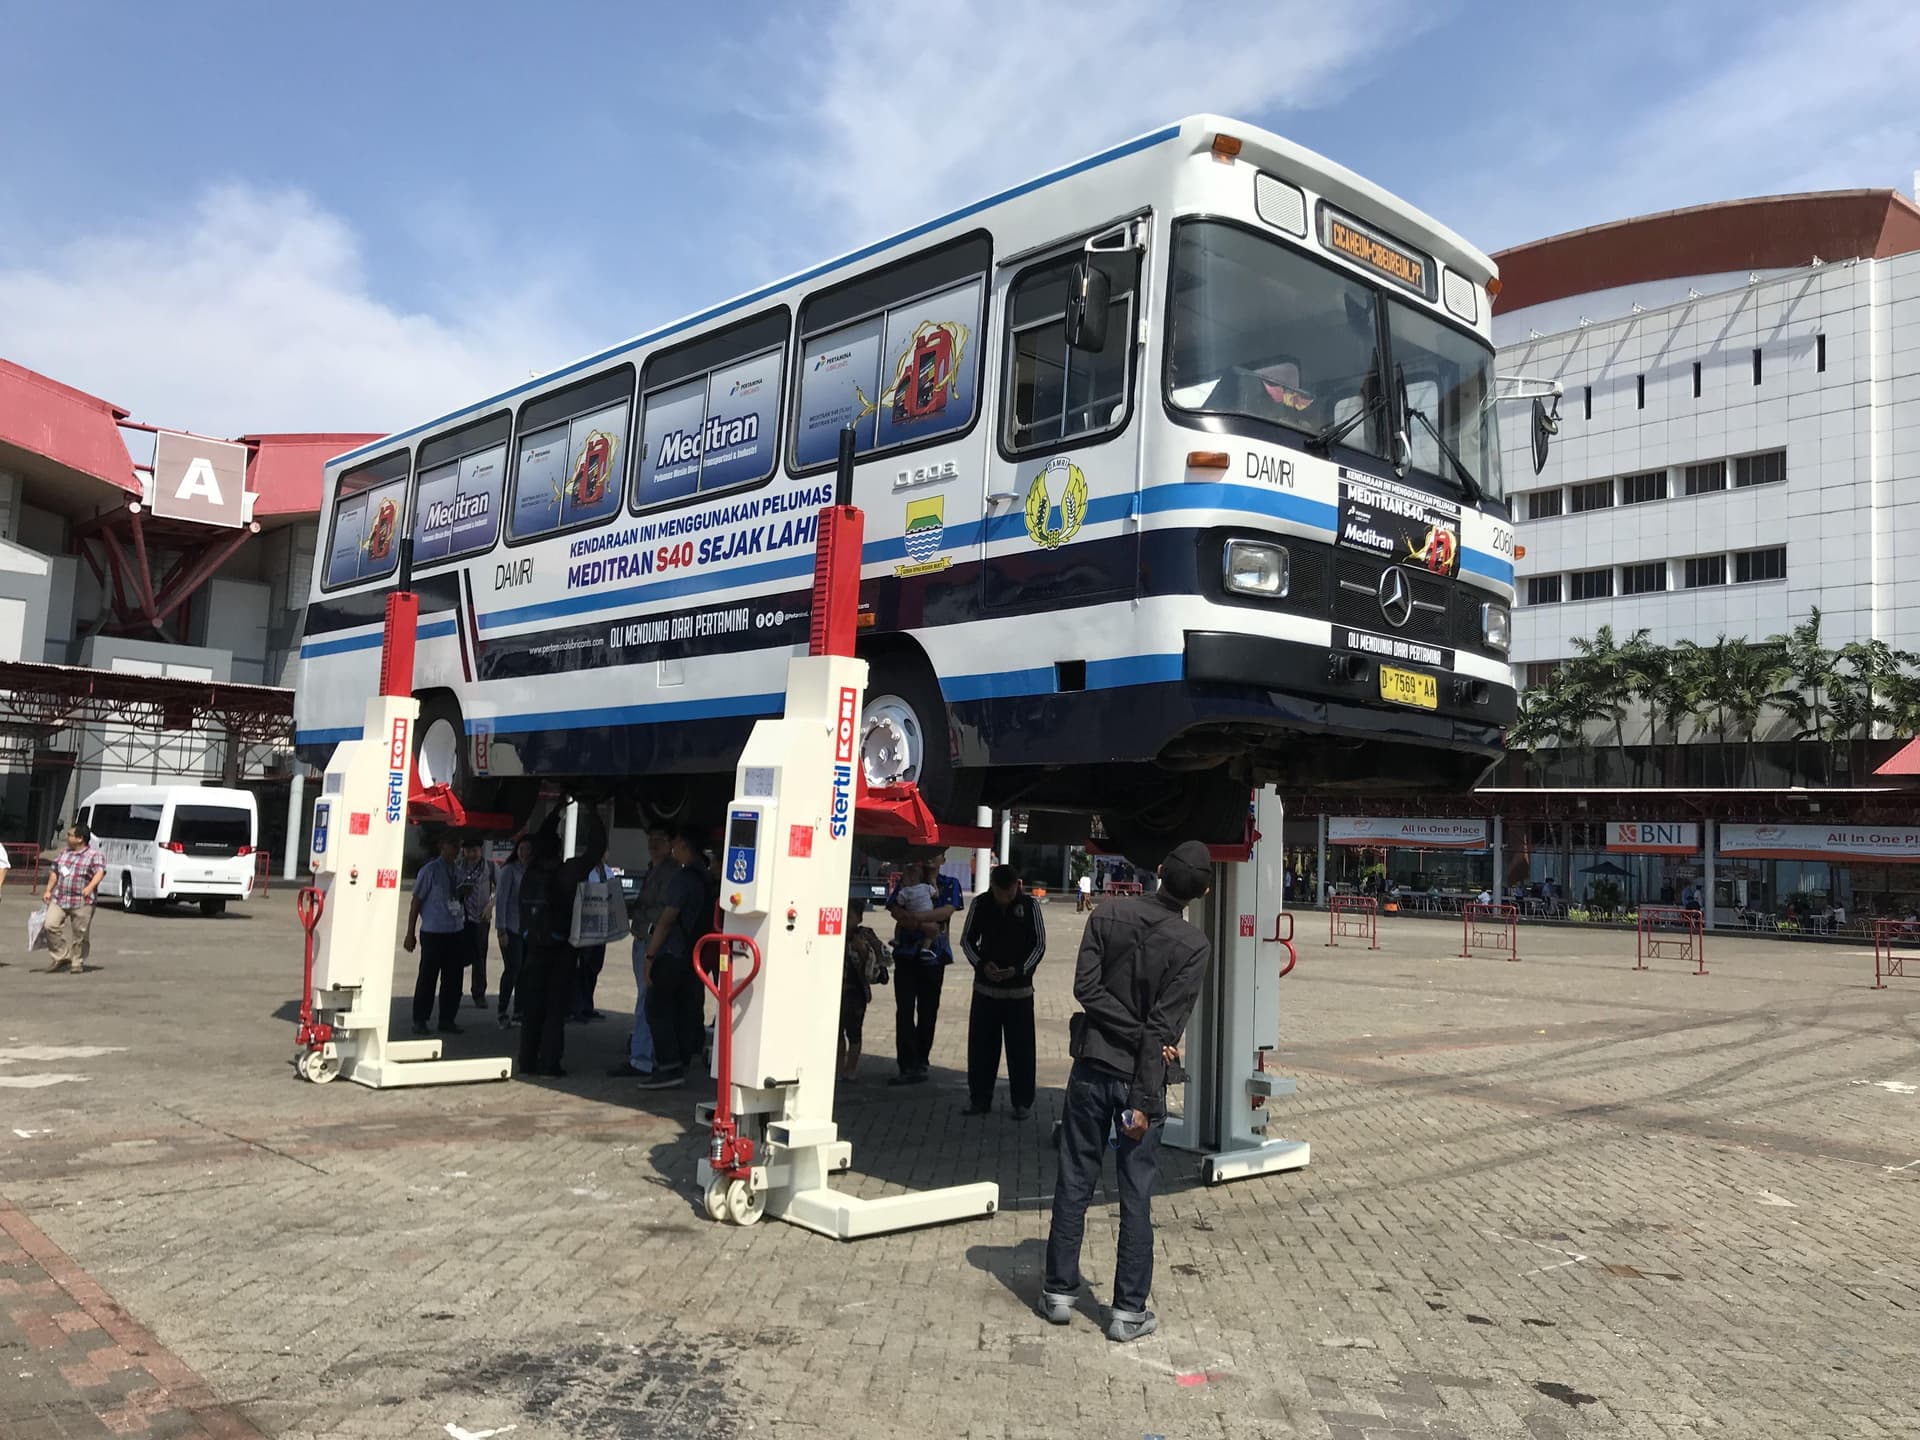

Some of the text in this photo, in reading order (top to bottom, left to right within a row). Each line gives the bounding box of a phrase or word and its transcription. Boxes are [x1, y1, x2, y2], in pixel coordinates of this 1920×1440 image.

[657, 413, 759, 468] Meditran
[175, 458, 224, 506] A
[1247, 452, 1295, 489] DAMRI
[1346, 470, 1383, 489] KENDARAAN
[1391, 483, 1433, 504] MENGGUNAKAN
[1433, 498, 1457, 513] PELUMAS
[1347, 484, 1424, 522] MEDITRAN S40
[570, 483, 833, 559] KENDARAAN INI MENGGUNAKAN PELUMAS
[1344, 523, 1394, 551] Meditran
[567, 514, 819, 589] MEDITRAN S40 SEJAK LAHI
[494, 557, 534, 591] DAMRI
[610, 607, 749, 649] OLI MENDUNIA DARI PERTAMINA
[529, 637, 604, 656] www.pertaminalubricants.com
[1348, 632, 1442, 666] OLI MENDUNIA DARI PERTAMINA
[1382, 670, 1388, 689] D
[1394, 673, 1416, 694] 7569
[1424, 679, 1436, 698] AA
[838, 691, 853, 759] KONI
[392, 720, 406, 769] KONI
[387, 772, 404, 822] stertil
[830, 765, 851, 838] stertil
[1402, 824, 1480, 834] All In One Place
[1641, 824, 1682, 844] BNI
[1827, 833, 1846, 843] All
[1851, 834, 1865, 843] In
[1869, 834, 1900, 844] One
[378, 869, 397, 880] 7500
[820, 908, 841, 922] 7500
[825, 921, 834, 935] kg
[1240, 914, 1254, 927] 7500
